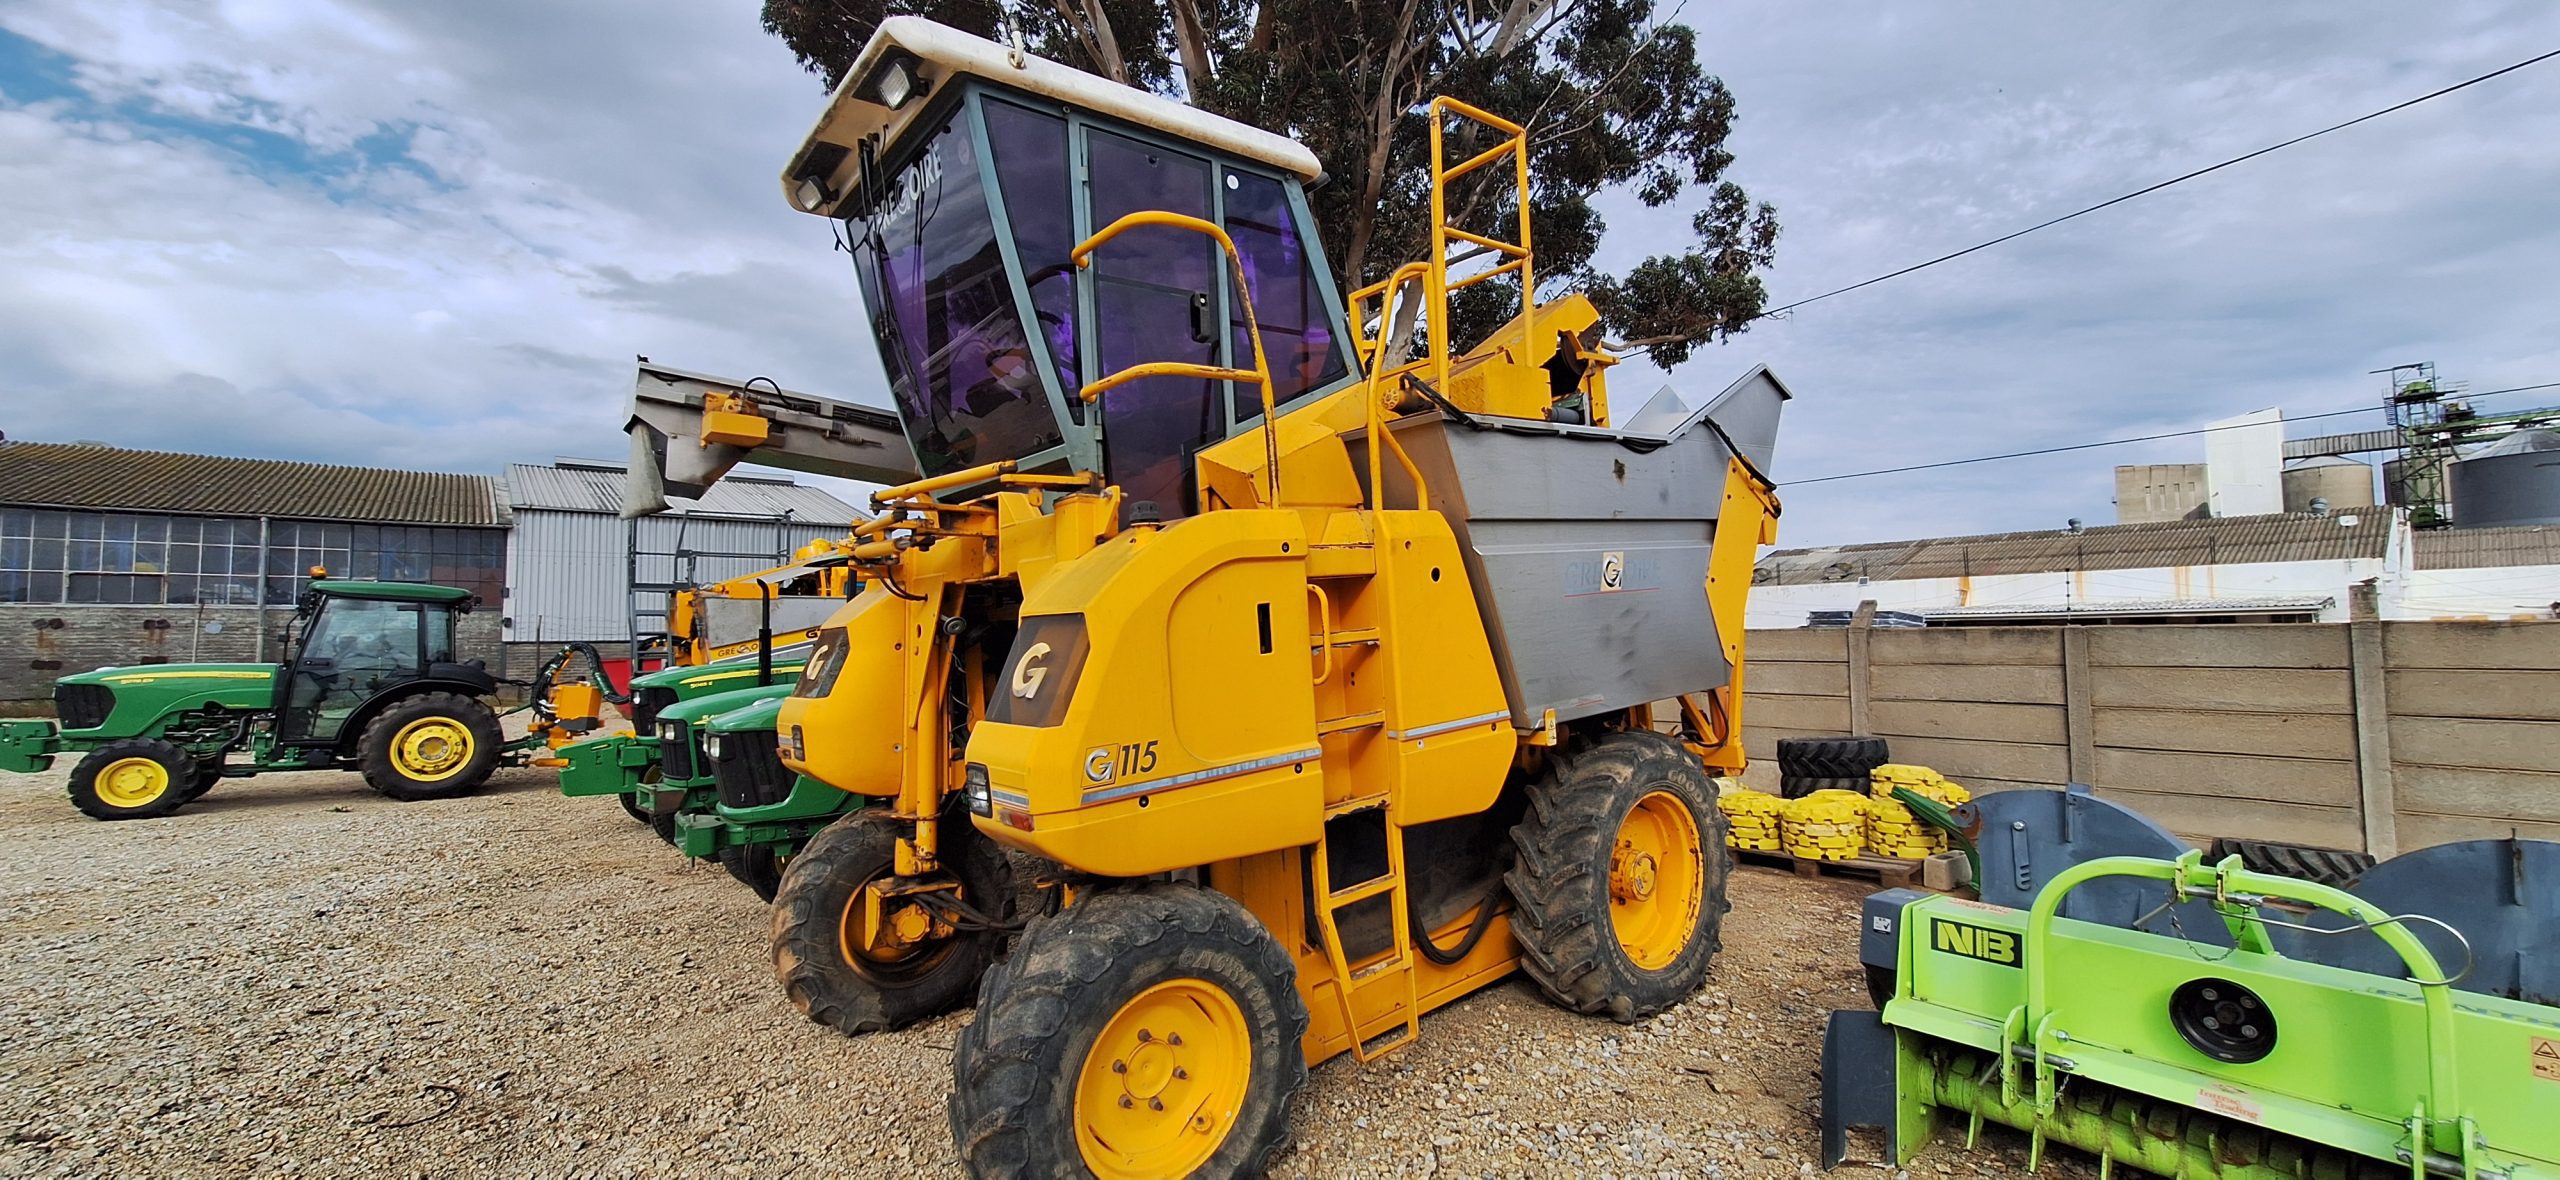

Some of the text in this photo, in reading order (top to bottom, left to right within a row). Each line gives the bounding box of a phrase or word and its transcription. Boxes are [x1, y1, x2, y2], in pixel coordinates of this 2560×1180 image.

[718, 643, 758, 657] GREGO
[807, 645, 828, 680] G
[1012, 642, 1051, 699] G
[1085, 740, 1158, 782] G 115
[1937, 921, 2015, 963] NB
